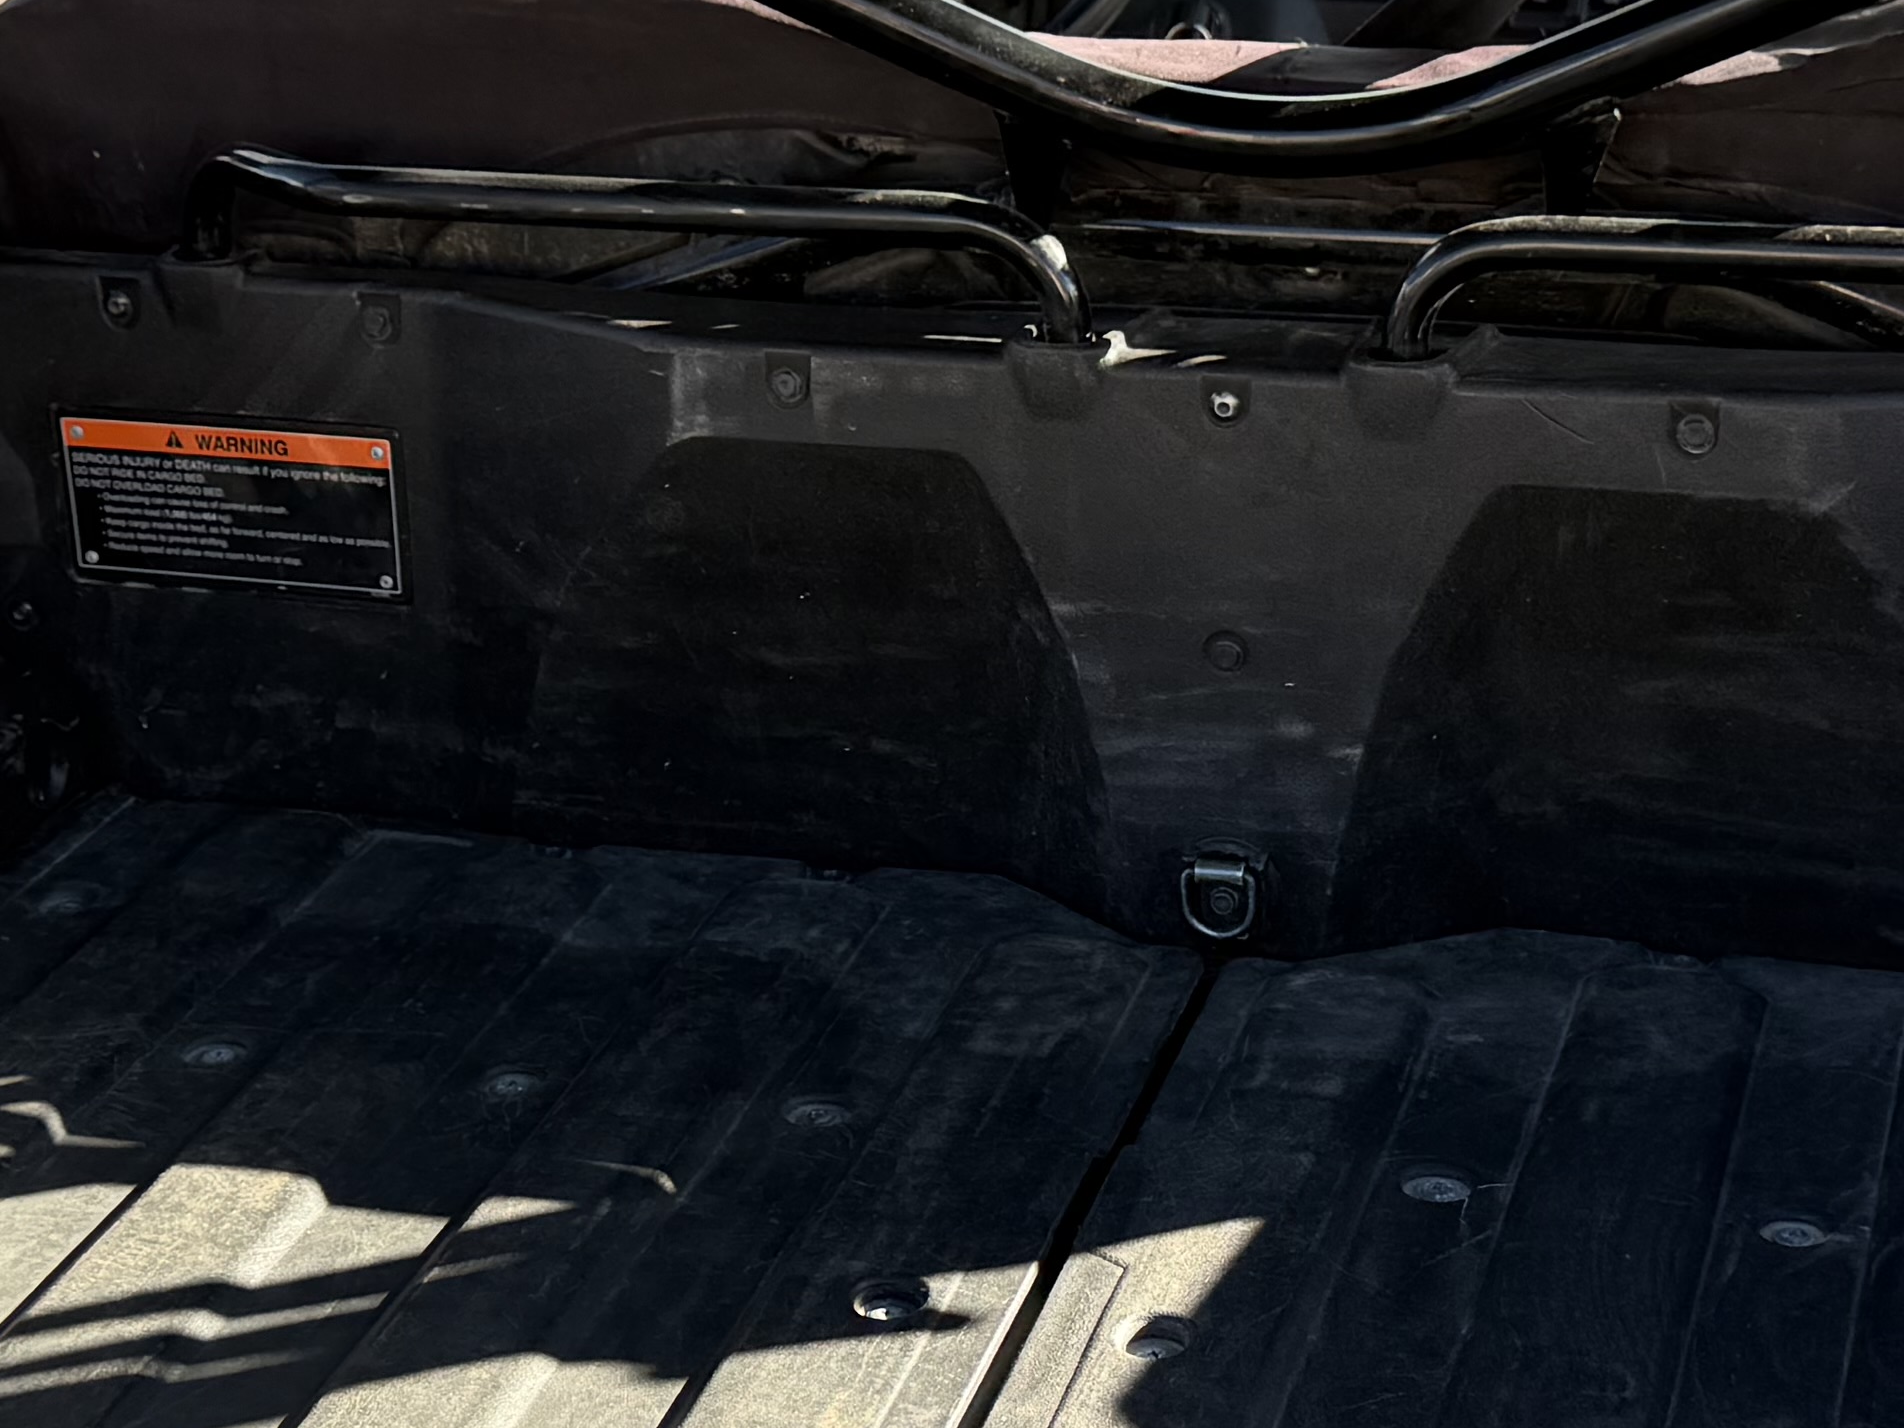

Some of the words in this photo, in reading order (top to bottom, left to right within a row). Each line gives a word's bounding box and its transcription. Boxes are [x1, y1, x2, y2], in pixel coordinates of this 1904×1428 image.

[195, 434, 289, 457] WARNING
[72, 451, 120, 465] SERIOUS
[122, 456, 160, 468] INJURY
[162, 459, 173, 469] or
[175, 459, 211, 471] DEATH
[213, 463, 232, 473] can
[232, 465, 261, 475] result
[262, 466, 268, 476] if
[270, 468, 289, 479] you
[290, 471, 321, 481] ignore
[322, 471, 339, 482] the
[73, 465, 88, 475] DO
[89, 467, 110, 476] NOT
[111, 468, 134, 479] RIDE
[136, 471, 146, 479] IN
[147, 470, 182, 482] CARGO
[75, 477, 90, 487] DO
[90, 479, 111, 489] NOT
[112, 480, 165, 493] OVERLOAD
[166, 484, 201, 495] CARGO
